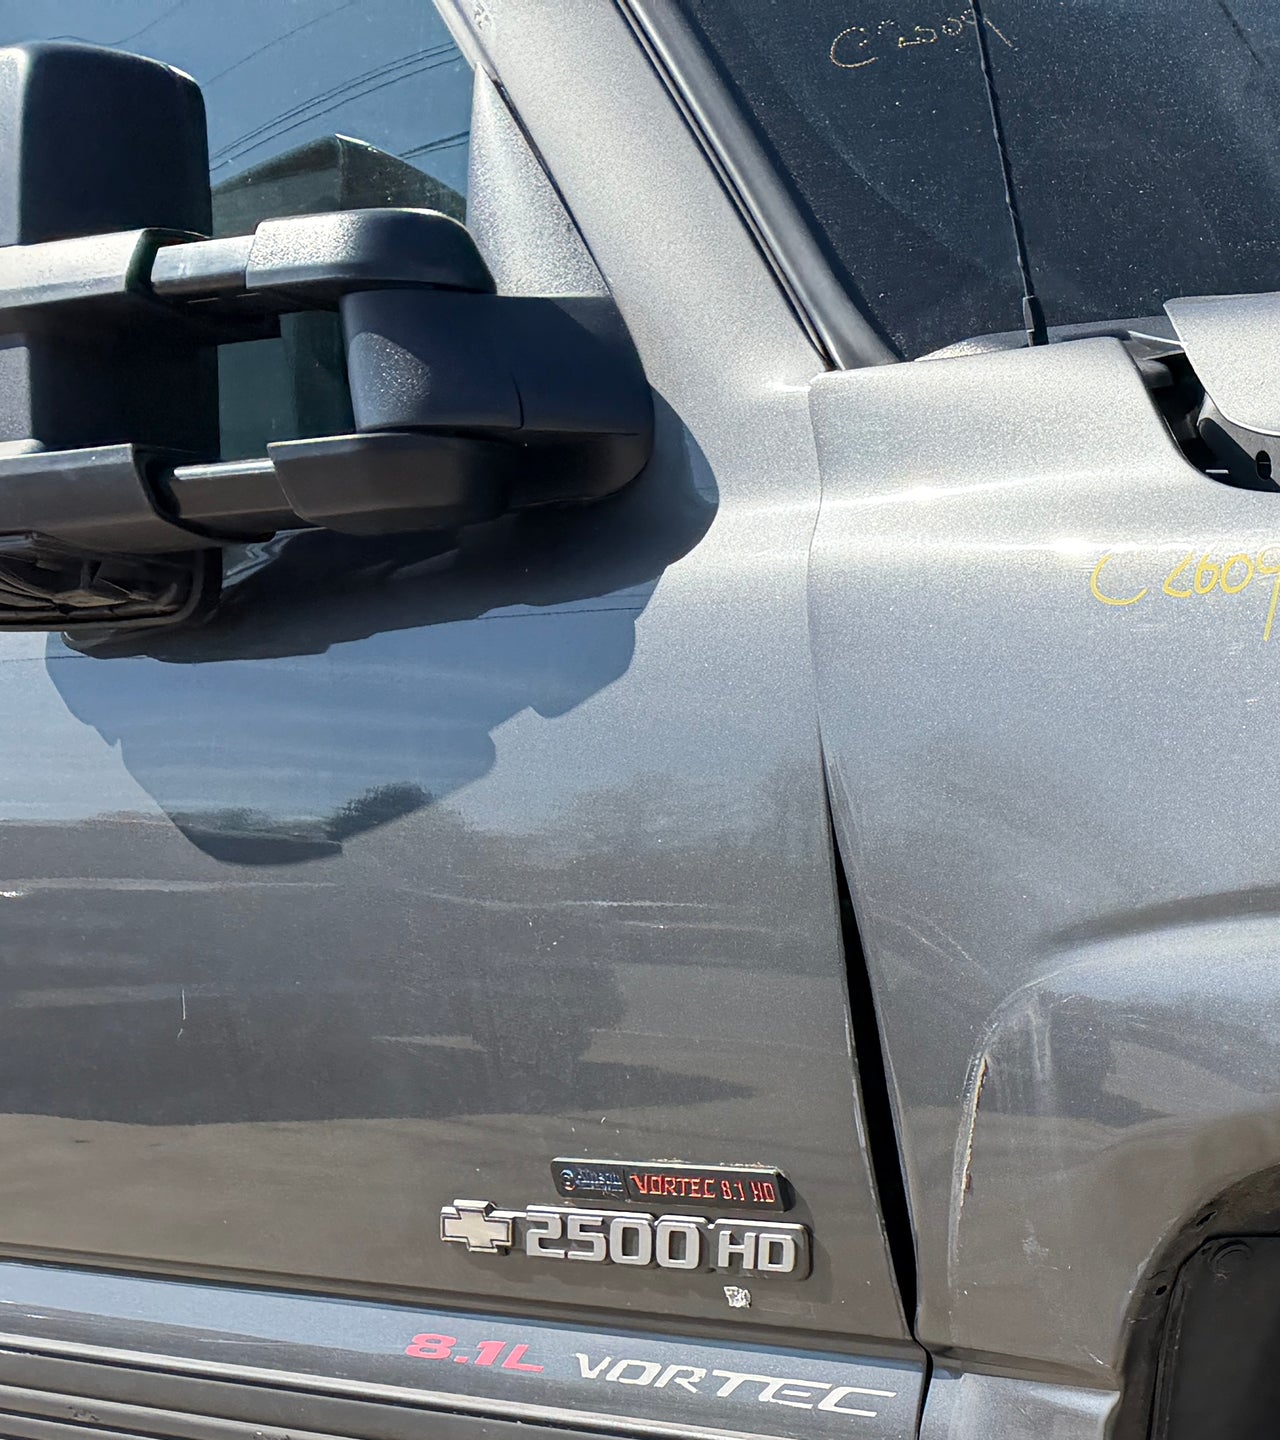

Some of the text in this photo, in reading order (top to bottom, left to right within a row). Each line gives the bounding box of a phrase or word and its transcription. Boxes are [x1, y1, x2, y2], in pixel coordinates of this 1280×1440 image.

[630, 1173, 717, 1199] VORTEC
[720, 1179, 746, 1201] 8.1
[751, 1181, 777, 1203] HD
[525, 1211, 797, 1274] 2500 HD
[404, 1332, 899, 1419] 8.1L VORTEC
